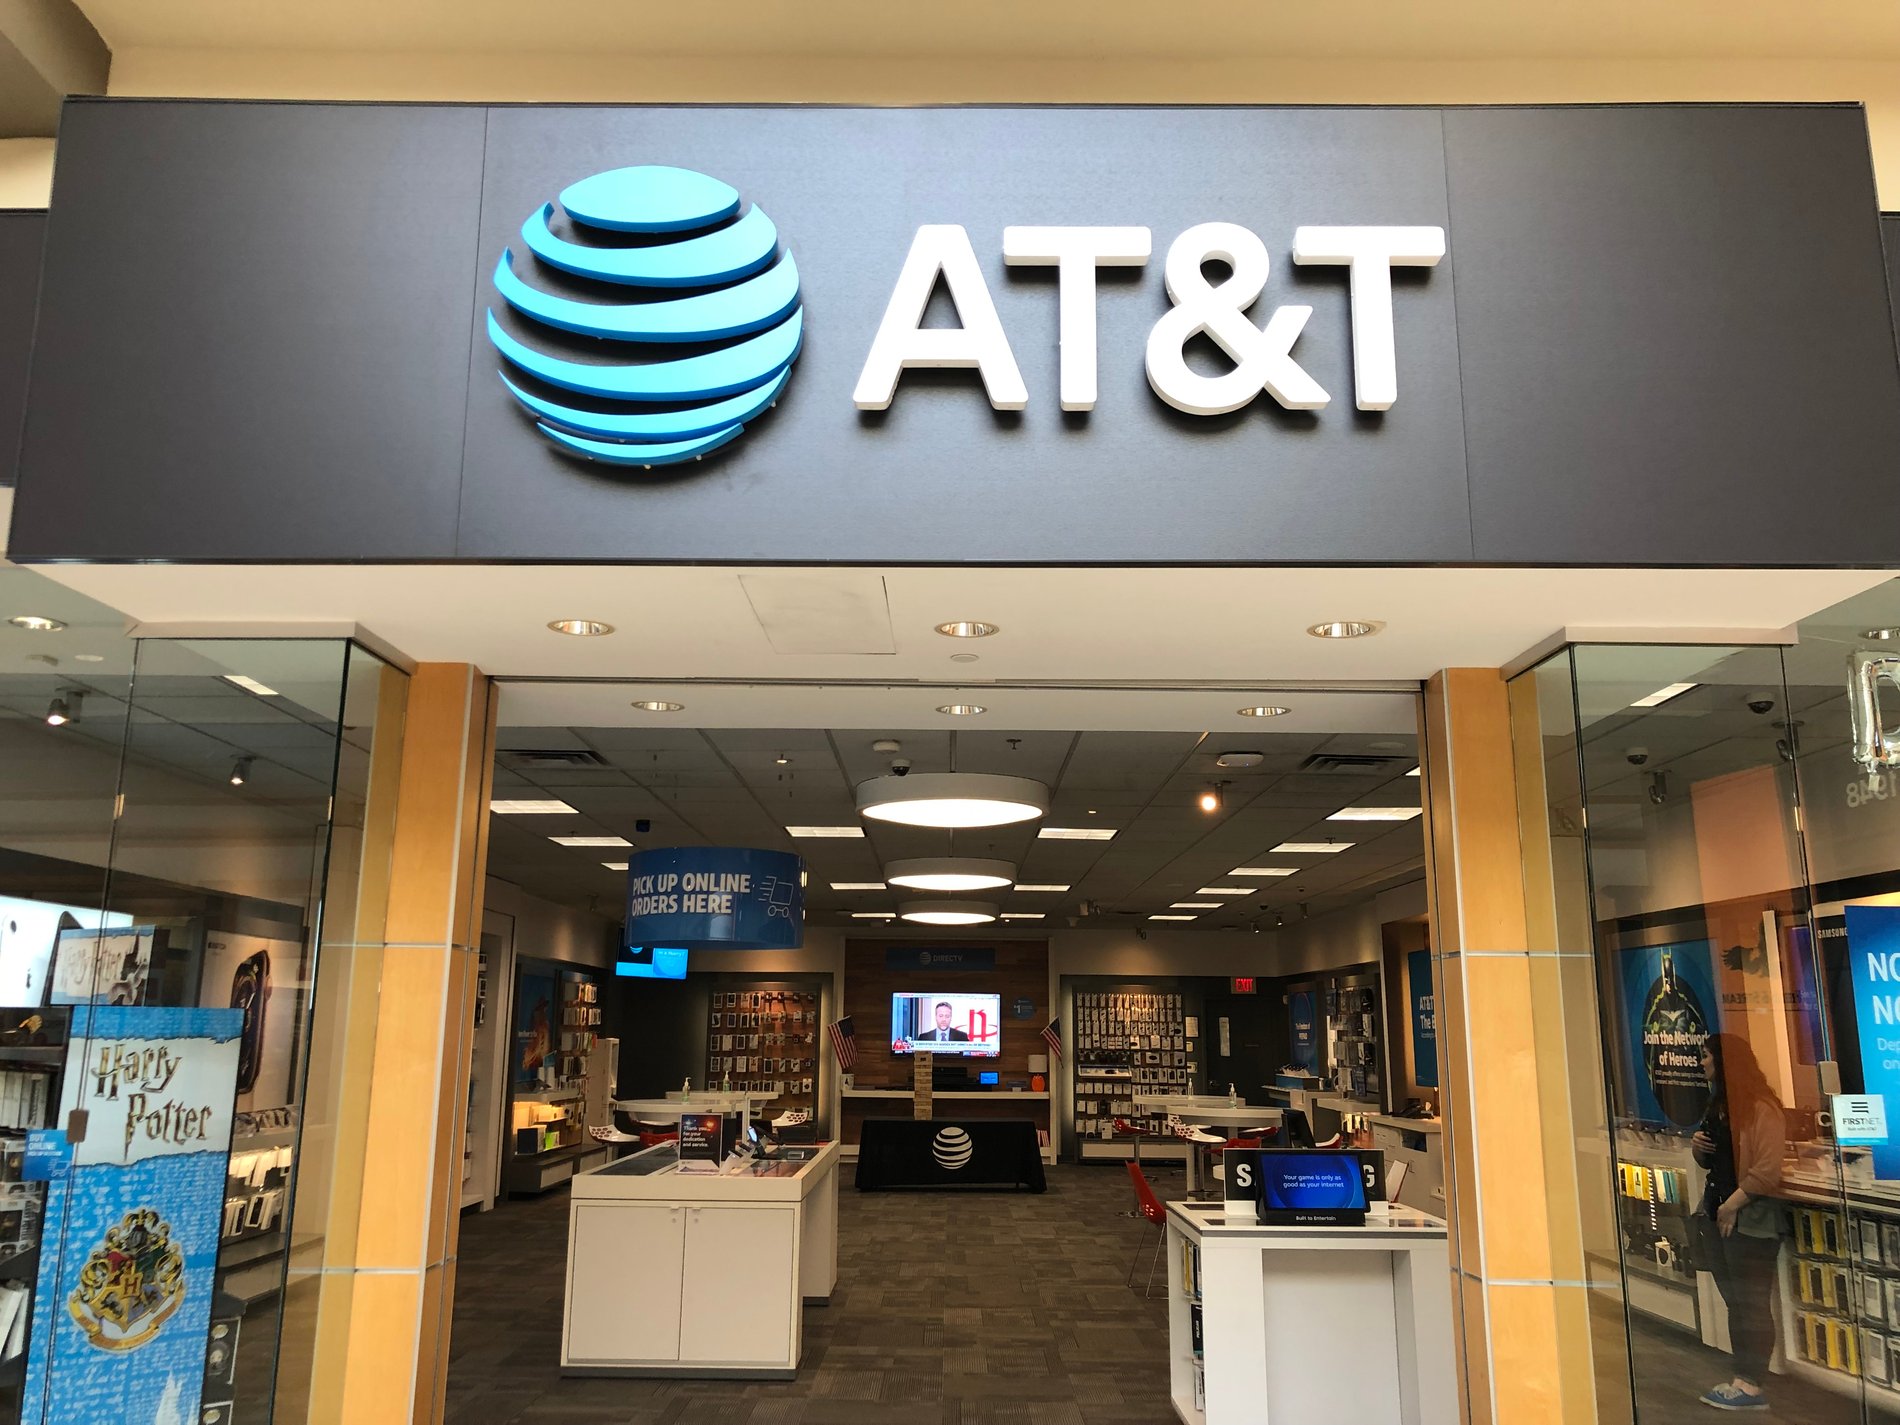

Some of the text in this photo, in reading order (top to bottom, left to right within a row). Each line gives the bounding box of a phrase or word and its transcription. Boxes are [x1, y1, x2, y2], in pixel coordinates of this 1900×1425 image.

[852, 221, 1446, 416] AT&T
[632, 872, 751, 896] PICK UP ONLINE
[632, 894, 733, 917] ORDERS HERE
[933, 954, 963, 962] DIRECTV
[1235, 978, 1253, 992] EXIT
[1420, 1015, 1431, 1029] The
[1643, 1030, 1659, 1045] Join
[1659, 1030, 1674, 1045] the
[1659, 1051, 1698, 1067] of Heroes
[91, 1044, 183, 1101] Harry
[124, 1093, 213, 1161] Potter
[1321, 1174, 1334, 1182] only
